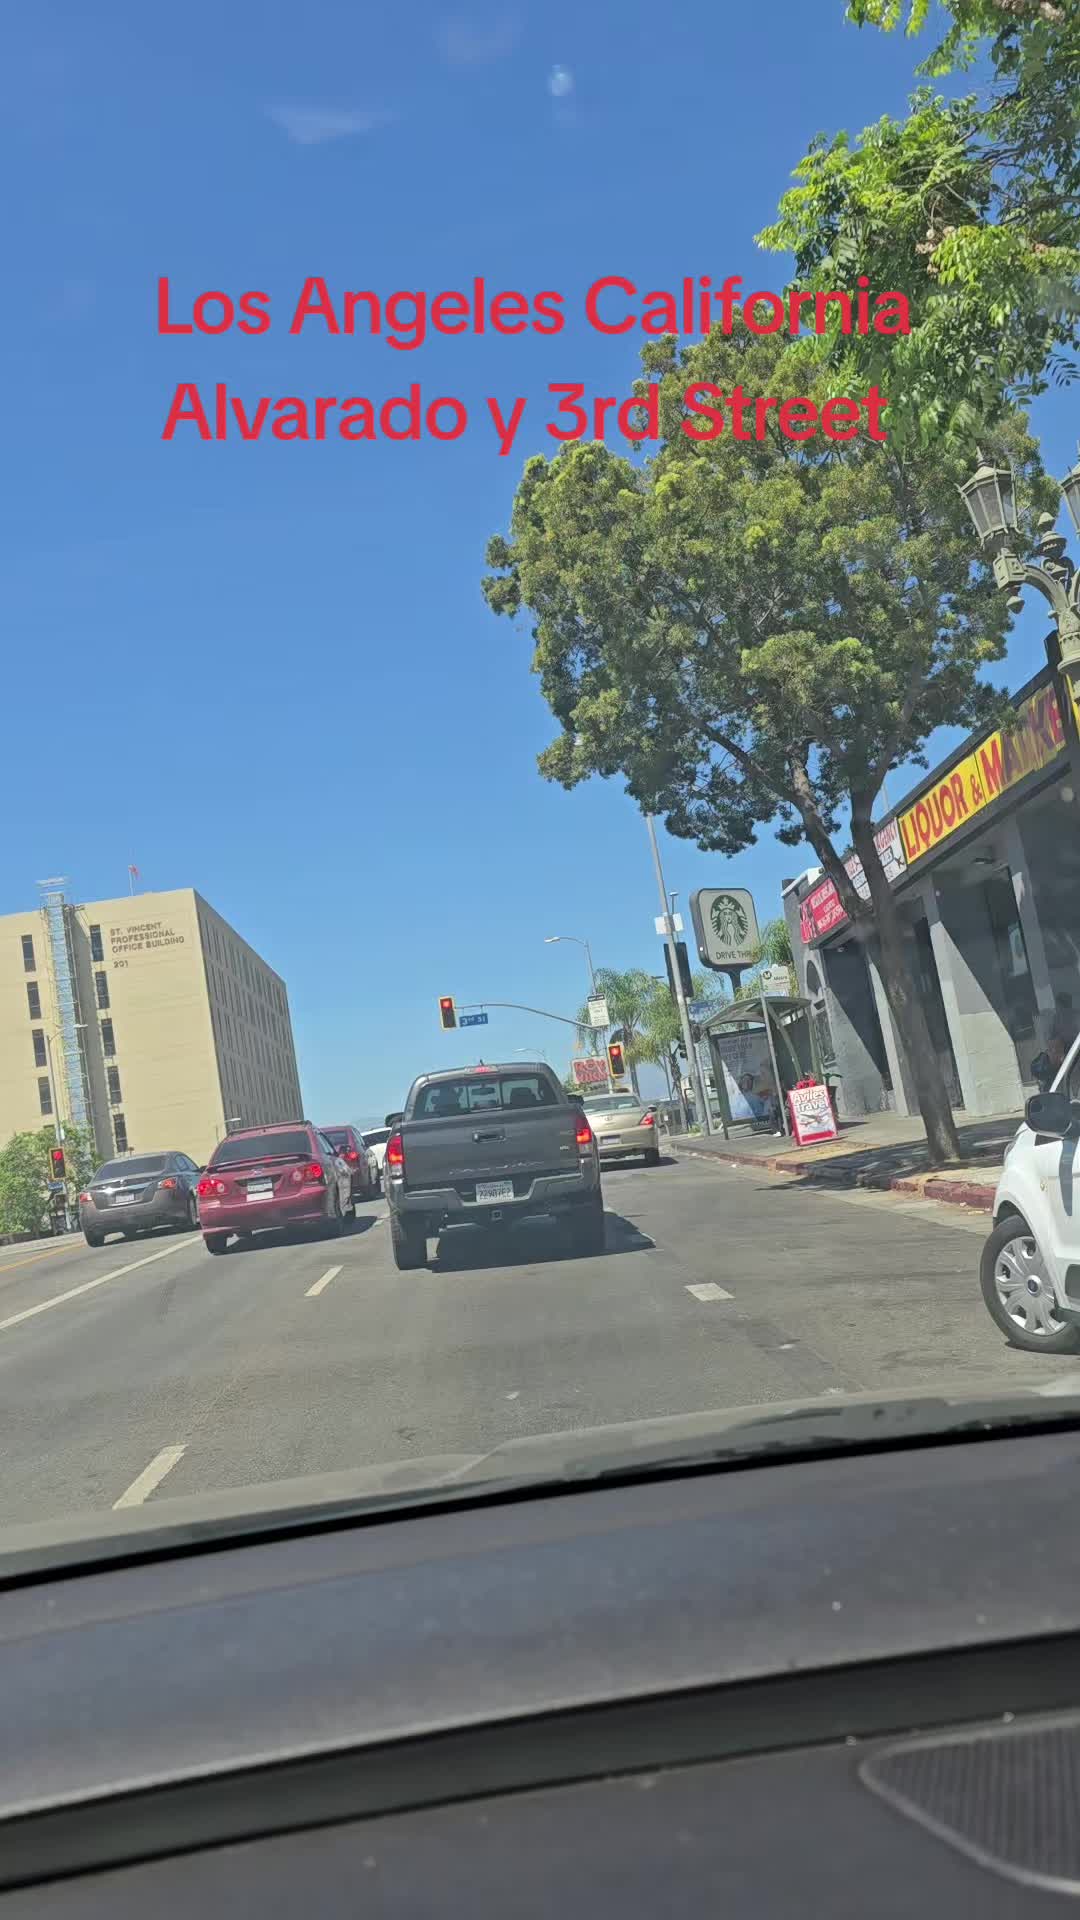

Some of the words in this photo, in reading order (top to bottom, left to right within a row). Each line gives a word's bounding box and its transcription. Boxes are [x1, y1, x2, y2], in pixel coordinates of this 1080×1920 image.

[900, 771, 970, 859] LIQUOR
[970, 773, 984, 806] &
[126, 922, 162, 934] VINCENT
[111, 928, 175, 945] PROFESSIONAL
[112, 942, 143, 953] OFFICE
[145, 936, 185, 949] BUILDING
[715, 951, 736, 960] DRIVE
[113, 960, 128, 968] 201
[794, 1090, 825, 1102] Aviles
